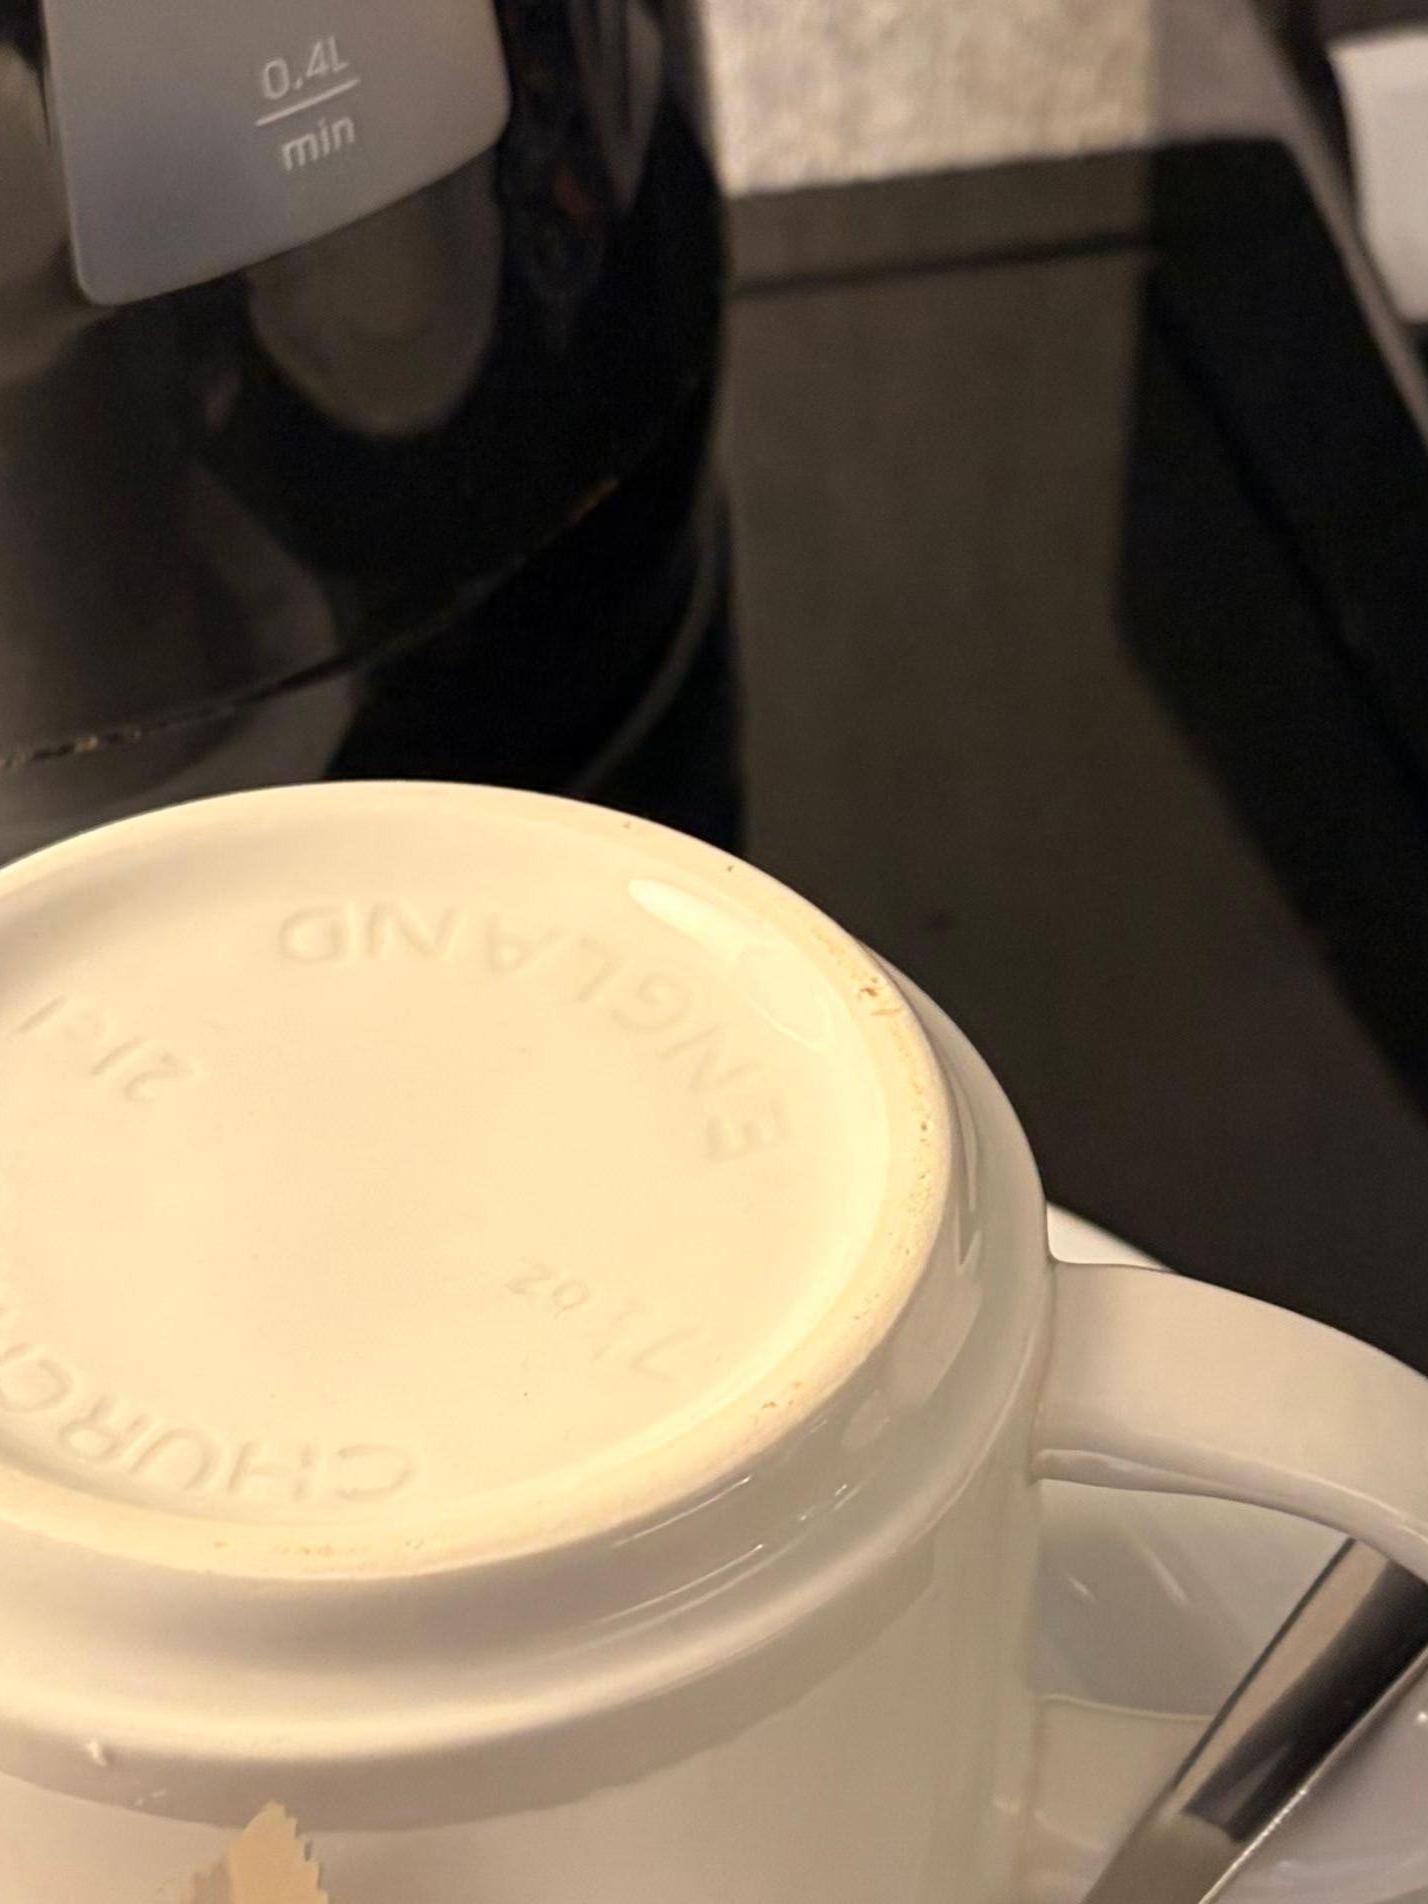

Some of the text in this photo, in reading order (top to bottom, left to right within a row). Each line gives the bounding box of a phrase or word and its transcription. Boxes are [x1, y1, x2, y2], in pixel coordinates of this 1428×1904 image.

[261, 36, 348, 101] 0.4L
[282, 113, 356, 171] min
[277, 899, 792, 1164] ENGLAND
